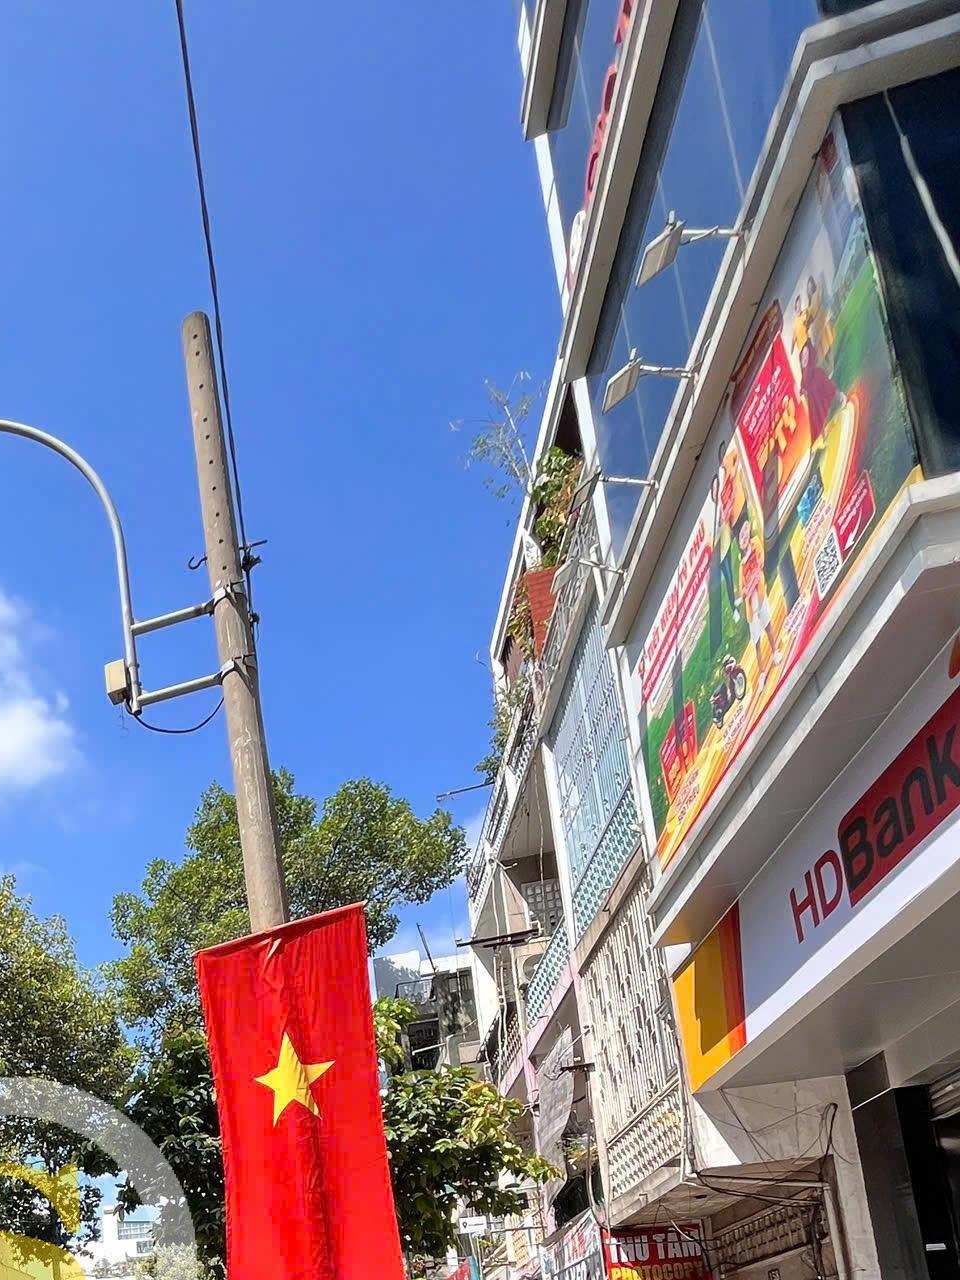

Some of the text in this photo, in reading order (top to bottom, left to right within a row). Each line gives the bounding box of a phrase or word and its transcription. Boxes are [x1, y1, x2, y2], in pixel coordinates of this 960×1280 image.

[790, 724, 960, 945] HDBank
[609, 1227, 703, 1264] THU TÂM
